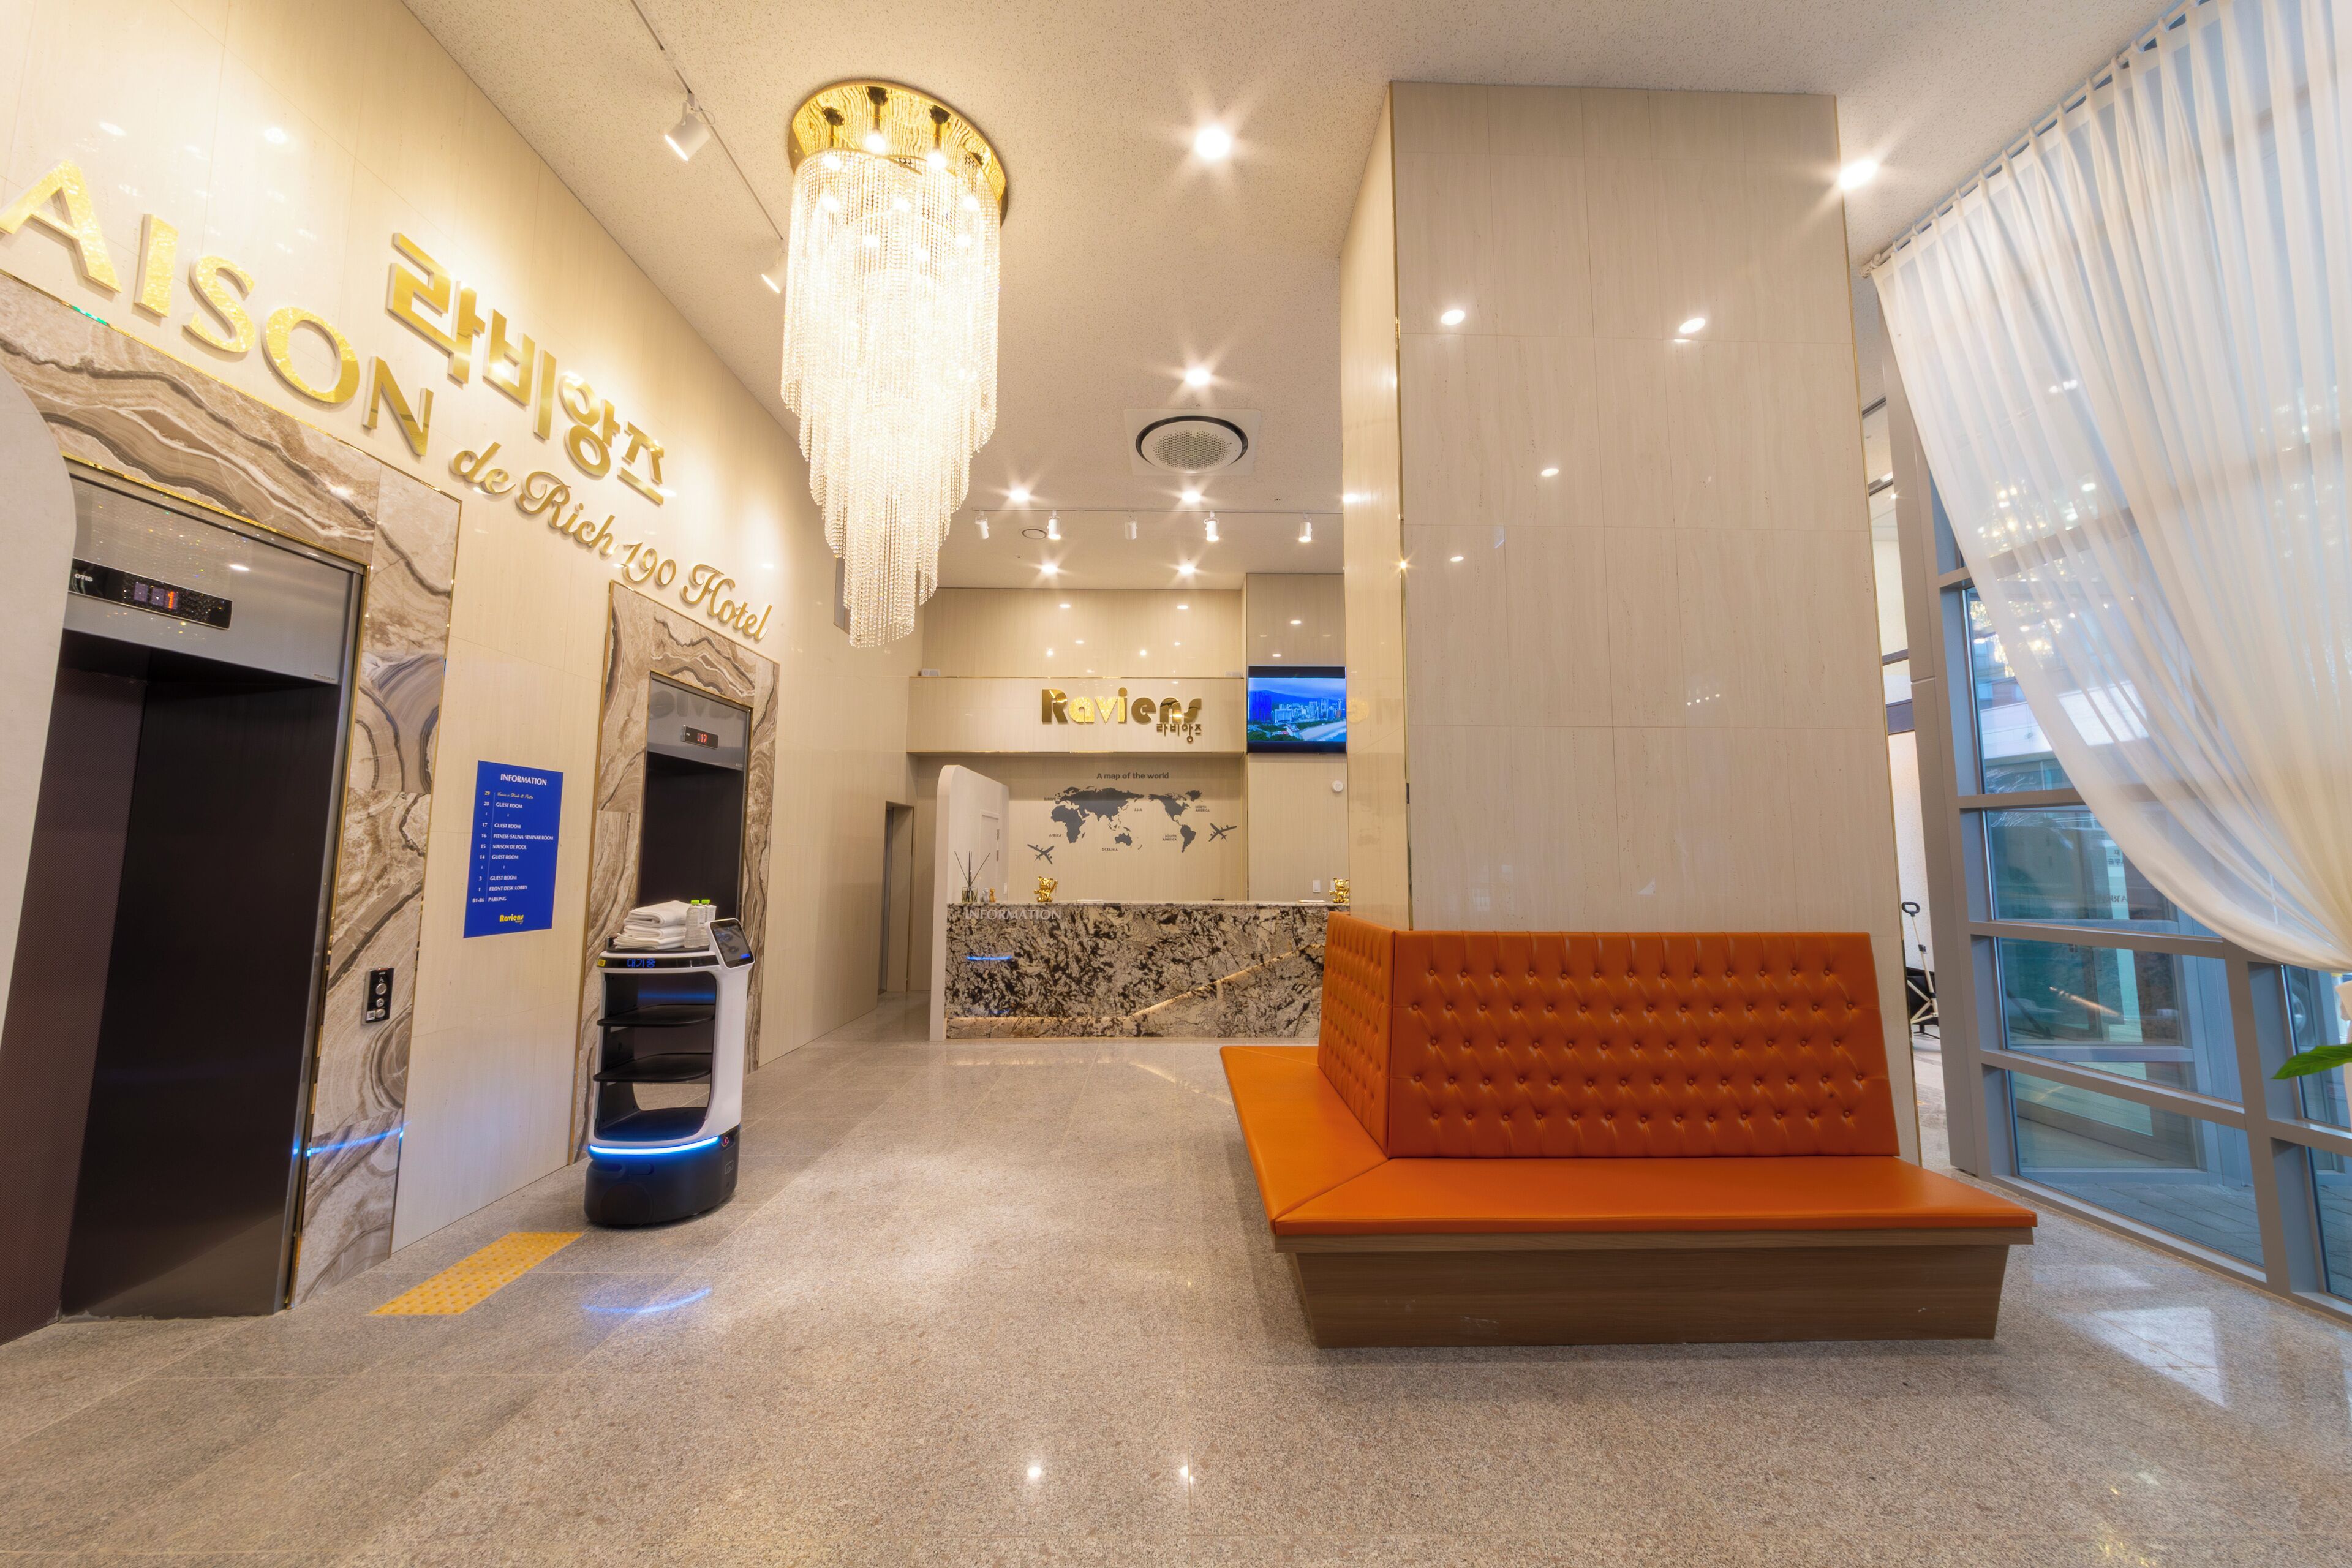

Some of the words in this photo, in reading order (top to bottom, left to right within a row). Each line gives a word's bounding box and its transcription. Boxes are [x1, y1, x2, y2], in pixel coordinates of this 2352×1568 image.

[0, 160, 434, 456] AISON
[386, 232, 664, 505] 라비앙즈
[449, 442, 516, 495] de
[515, 470, 619, 557] Rich
[621, 541, 677, 587] 190
[680, 564, 772, 641] Hotel
[74, 573, 93, 582] OTIS
[1042, 687, 1202, 723] Raviens
[1156, 723, 1202, 743] 라비앙즈
[500, 774, 548, 786] INFORMATION
[965, 910, 1061, 920] INFORMATION
[627, 957, 656, 968] 대기중
